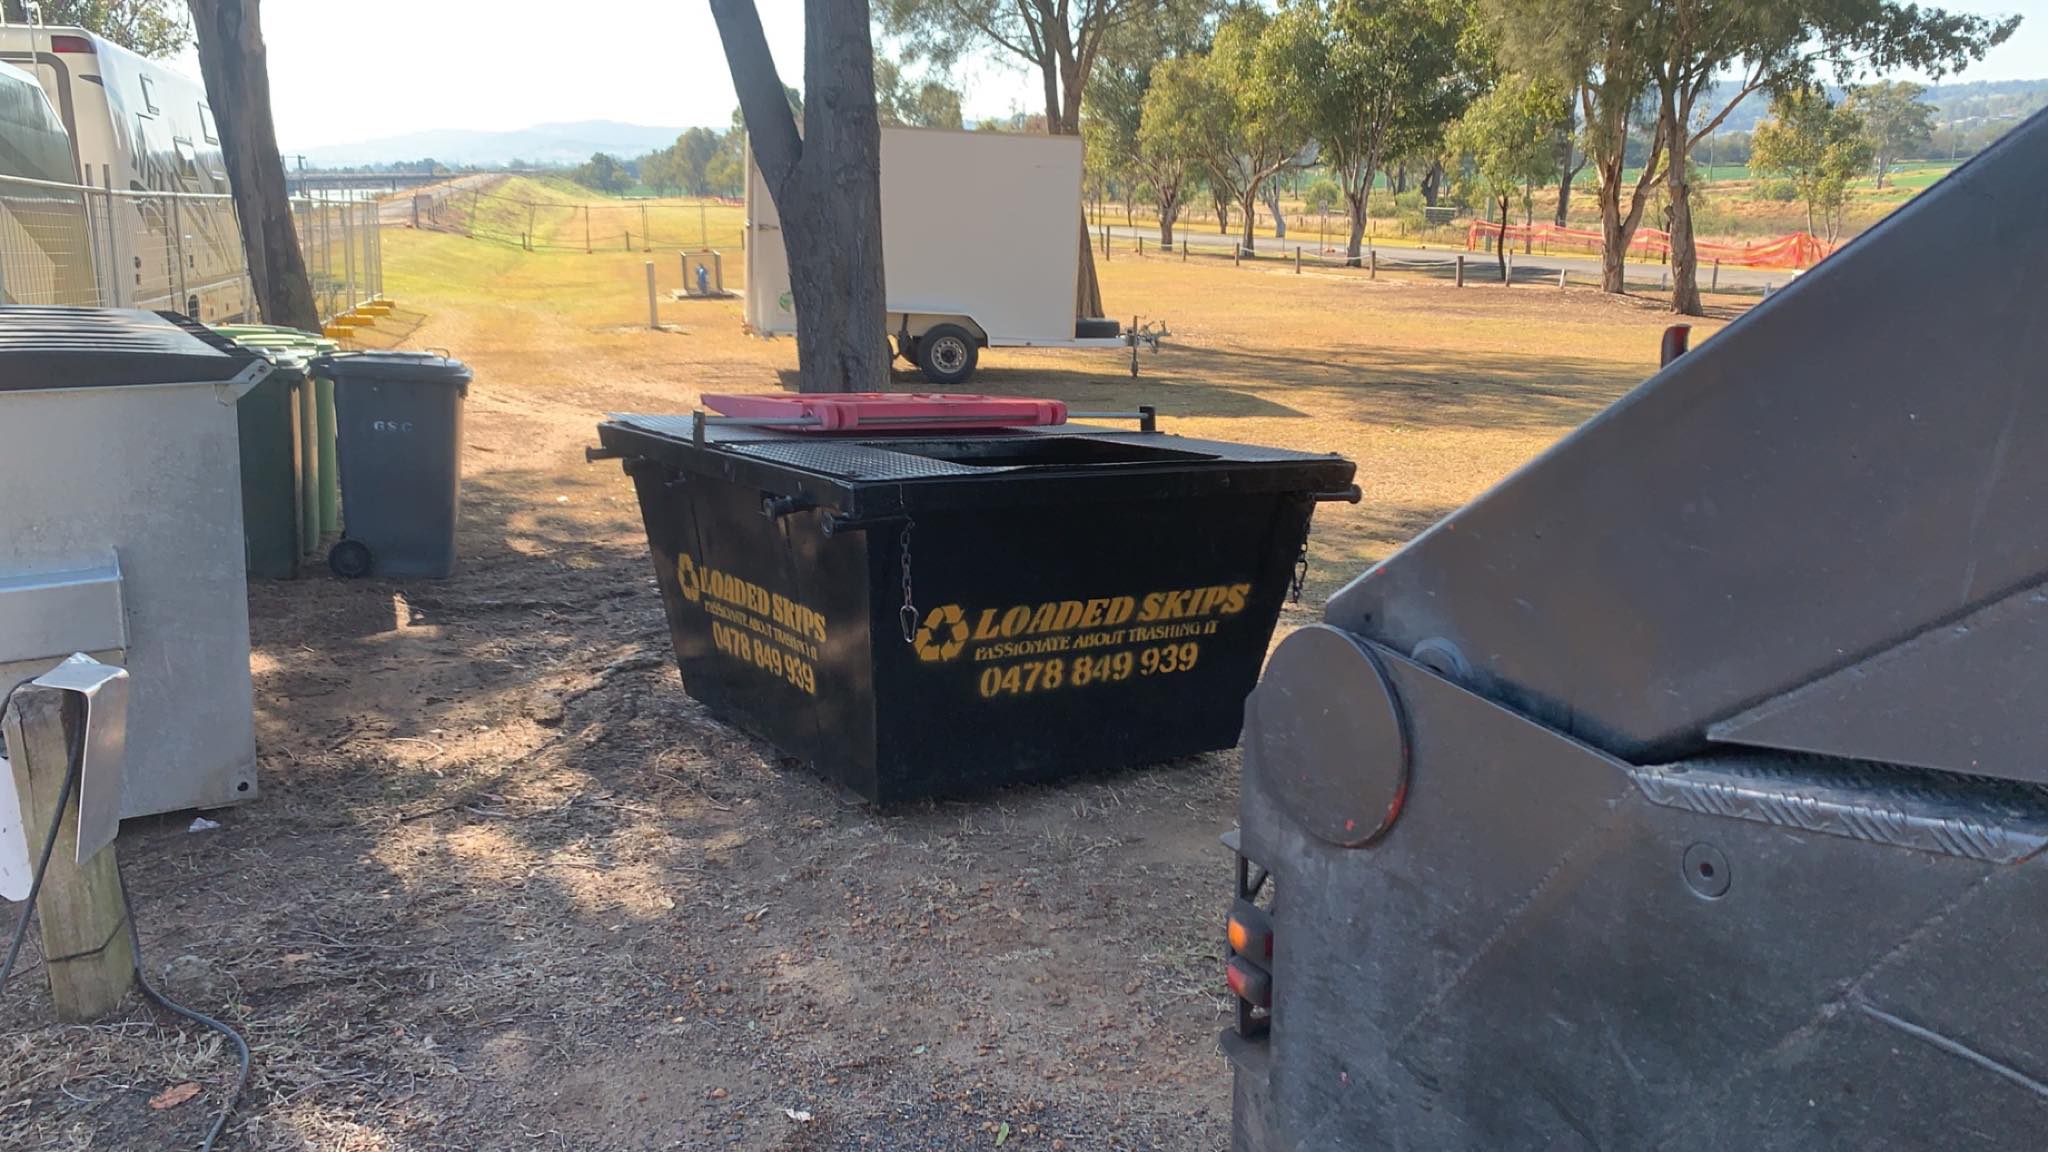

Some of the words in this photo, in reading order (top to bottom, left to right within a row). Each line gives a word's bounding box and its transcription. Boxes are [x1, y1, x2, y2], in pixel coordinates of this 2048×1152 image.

[699, 567, 770, 615] LOADED
[772, 593, 827, 643] SKIPS
[973, 596, 1135, 640] LOADED
[1137, 583, 1250, 621] SKIPS
[712, 621, 751, 661] 0478
[753, 638, 783, 677] 849
[784, 654, 816, 695] 939
[975, 636, 1071, 661] PASSIONATE
[1073, 630, 1126, 649] ABOUT
[1128, 622, 1201, 642] TRASHING
[1203, 620, 1219, 634] IT
[980, 658, 1063, 698] 0478
[1071, 651, 1133, 687] 849
[1139, 641, 1199, 676] 939
